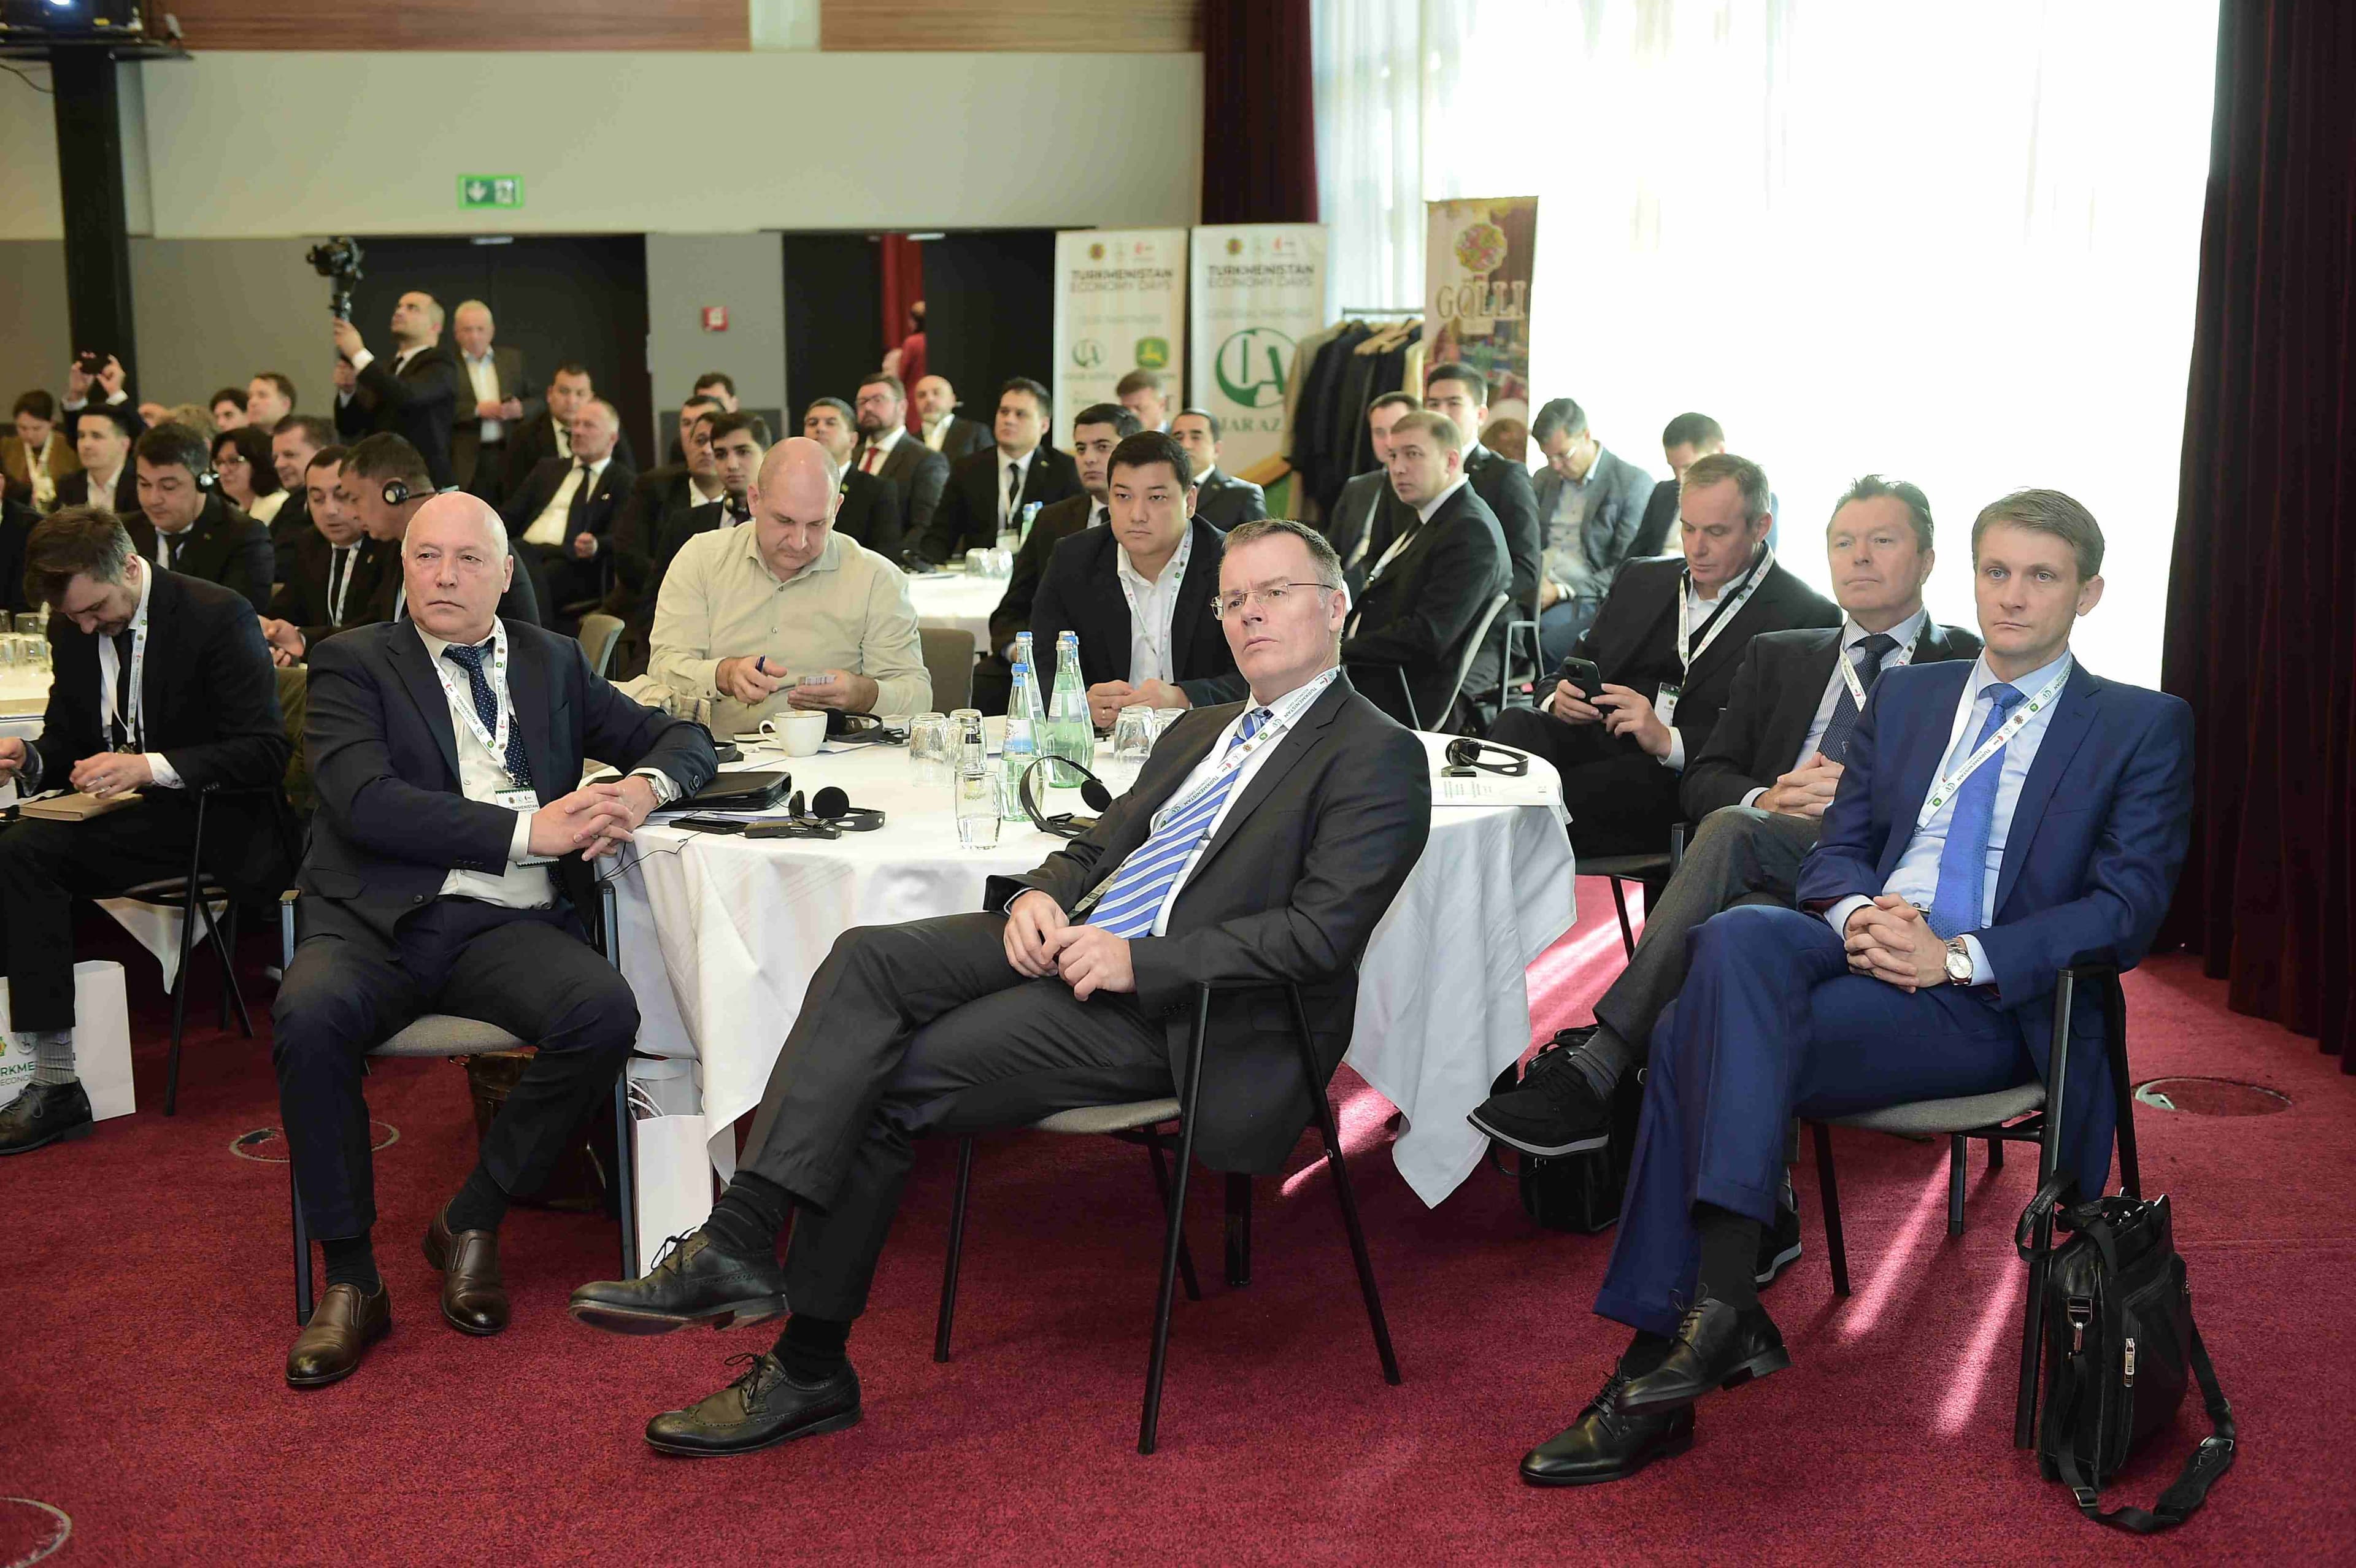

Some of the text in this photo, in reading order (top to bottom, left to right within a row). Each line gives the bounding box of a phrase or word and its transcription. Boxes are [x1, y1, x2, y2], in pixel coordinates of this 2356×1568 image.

[454, 694, 479, 725] TURKMENISTAN
[1283, 686, 1317, 718] TURKMENISTAN
[1956, 748, 1990, 782] TURKMENISTAN
[1183, 775, 1218, 806] TURKMENISTAN
[1, 1061, 35, 1077] RKME
[1, 1074, 29, 1086] ECONO
